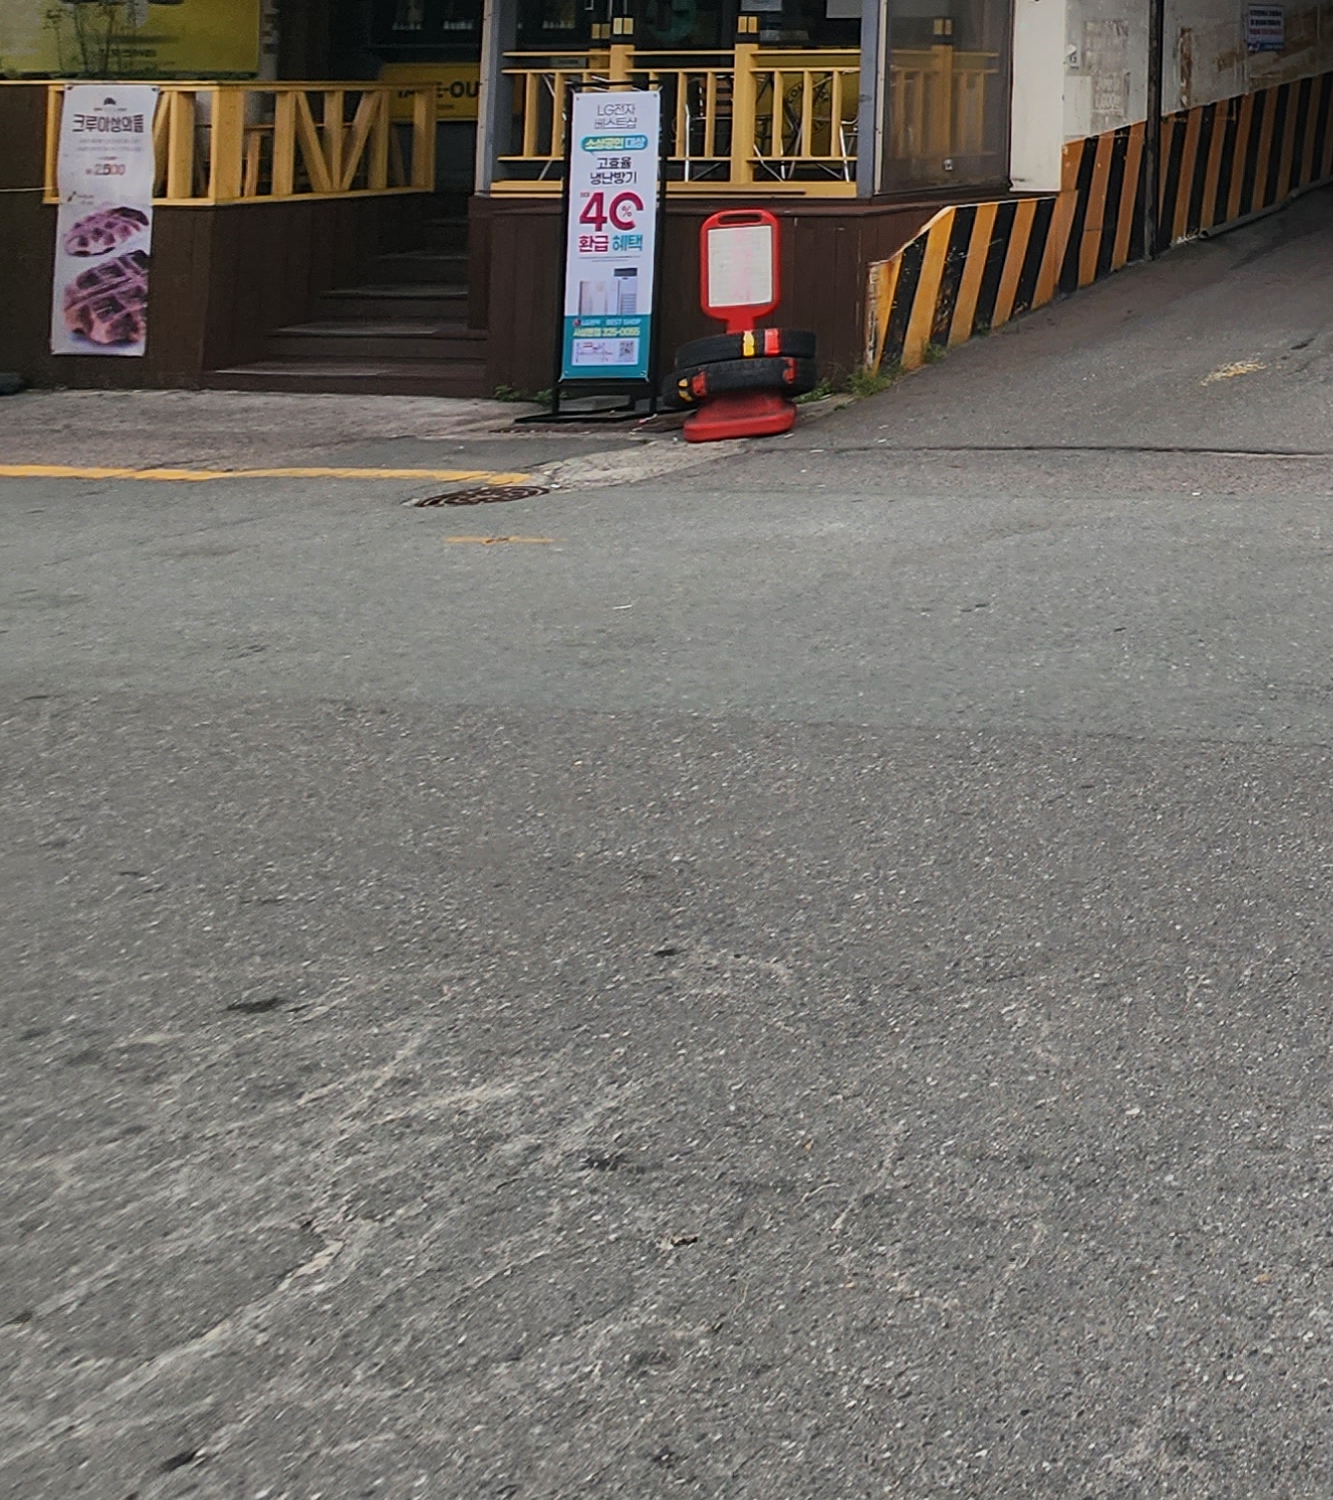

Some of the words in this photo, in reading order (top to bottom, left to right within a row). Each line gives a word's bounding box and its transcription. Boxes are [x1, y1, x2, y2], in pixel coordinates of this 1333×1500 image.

[597, 103, 636, 116] LG전자
[594, 117, 637, 129] 베스트샵
[596, 156, 632, 169] 고효율
[590, 171, 637, 185] 냉난방기
[578, 235, 609, 253] 환급
[612, 234, 643, 251] 혜택
